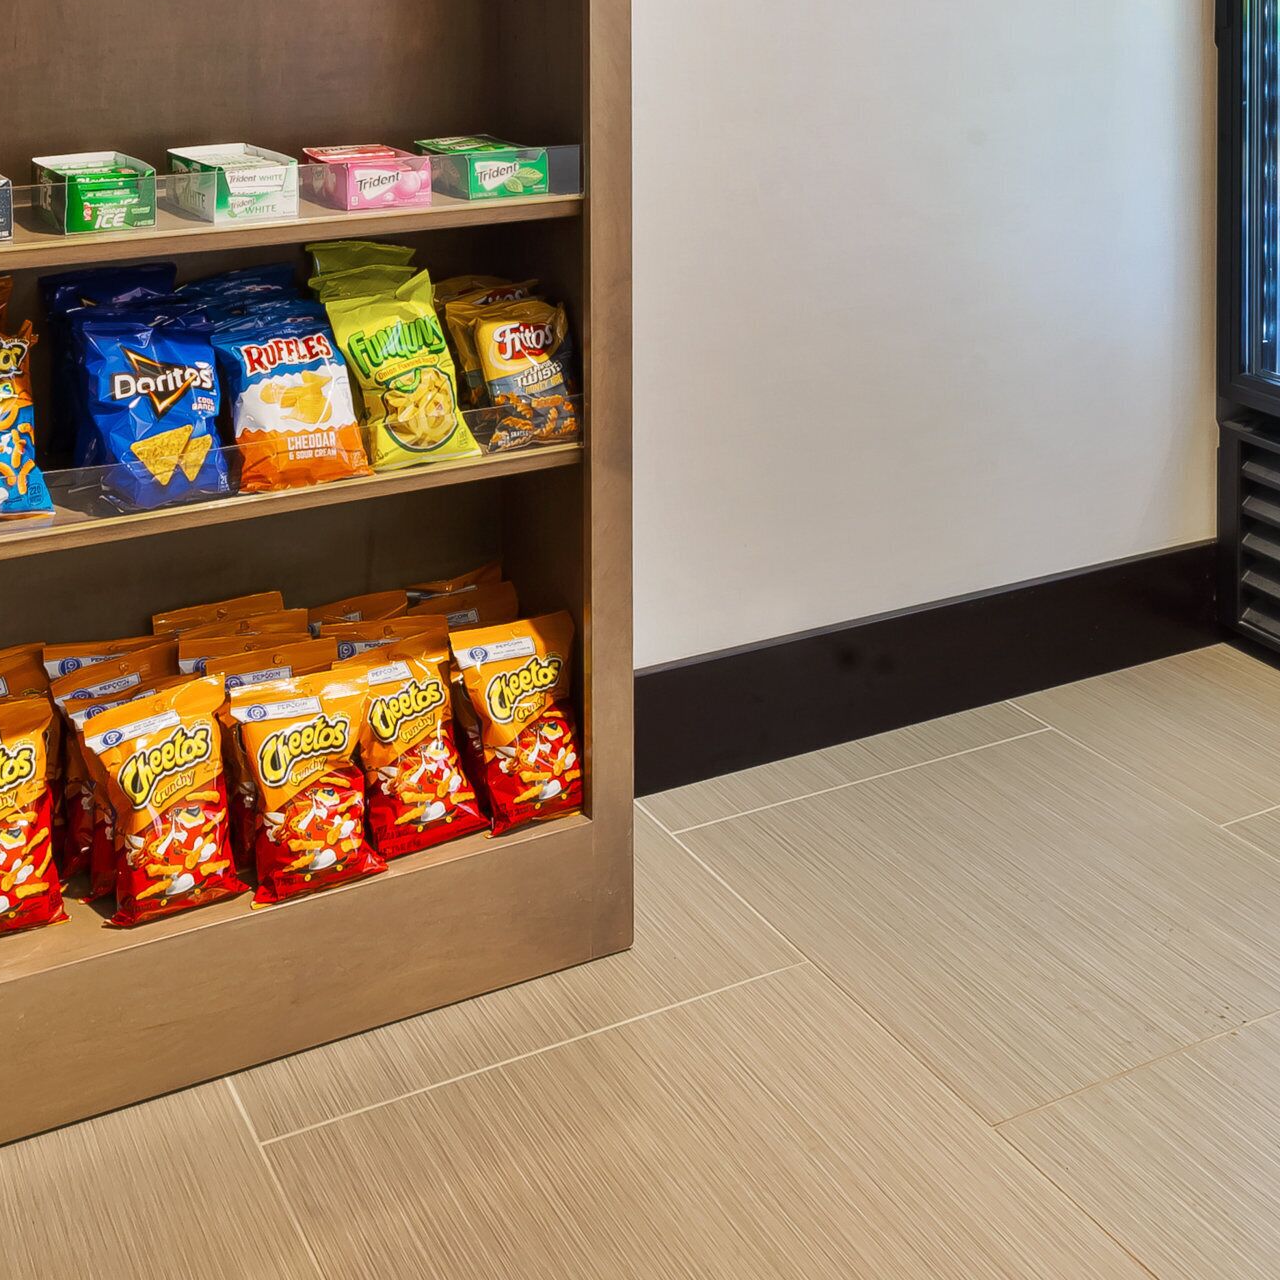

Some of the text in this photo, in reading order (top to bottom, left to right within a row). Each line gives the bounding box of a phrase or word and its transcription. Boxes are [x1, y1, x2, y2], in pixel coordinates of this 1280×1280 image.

[229, 175, 257, 183] Trident
[356, 172, 400, 191] Trident
[477, 163, 518, 184] Trident
[231, 198, 255, 209] Trident
[245, 204, 277, 214] WHITE
[243, 333, 332, 373] RUFFLES
[493, 322, 553, 359] Fritos
[114, 365, 213, 400] Doritos
[288, 433, 336, 451] CHEDDAR
[489, 659, 561, 723] Cheetos
[371, 682, 442, 740] Cheetos
[400, 714, 434, 742] Crunchy
[261, 720, 348, 785] Cheetos
[290, 758, 326, 784] Crunchy
[152, 771, 195, 806] Crunchy
